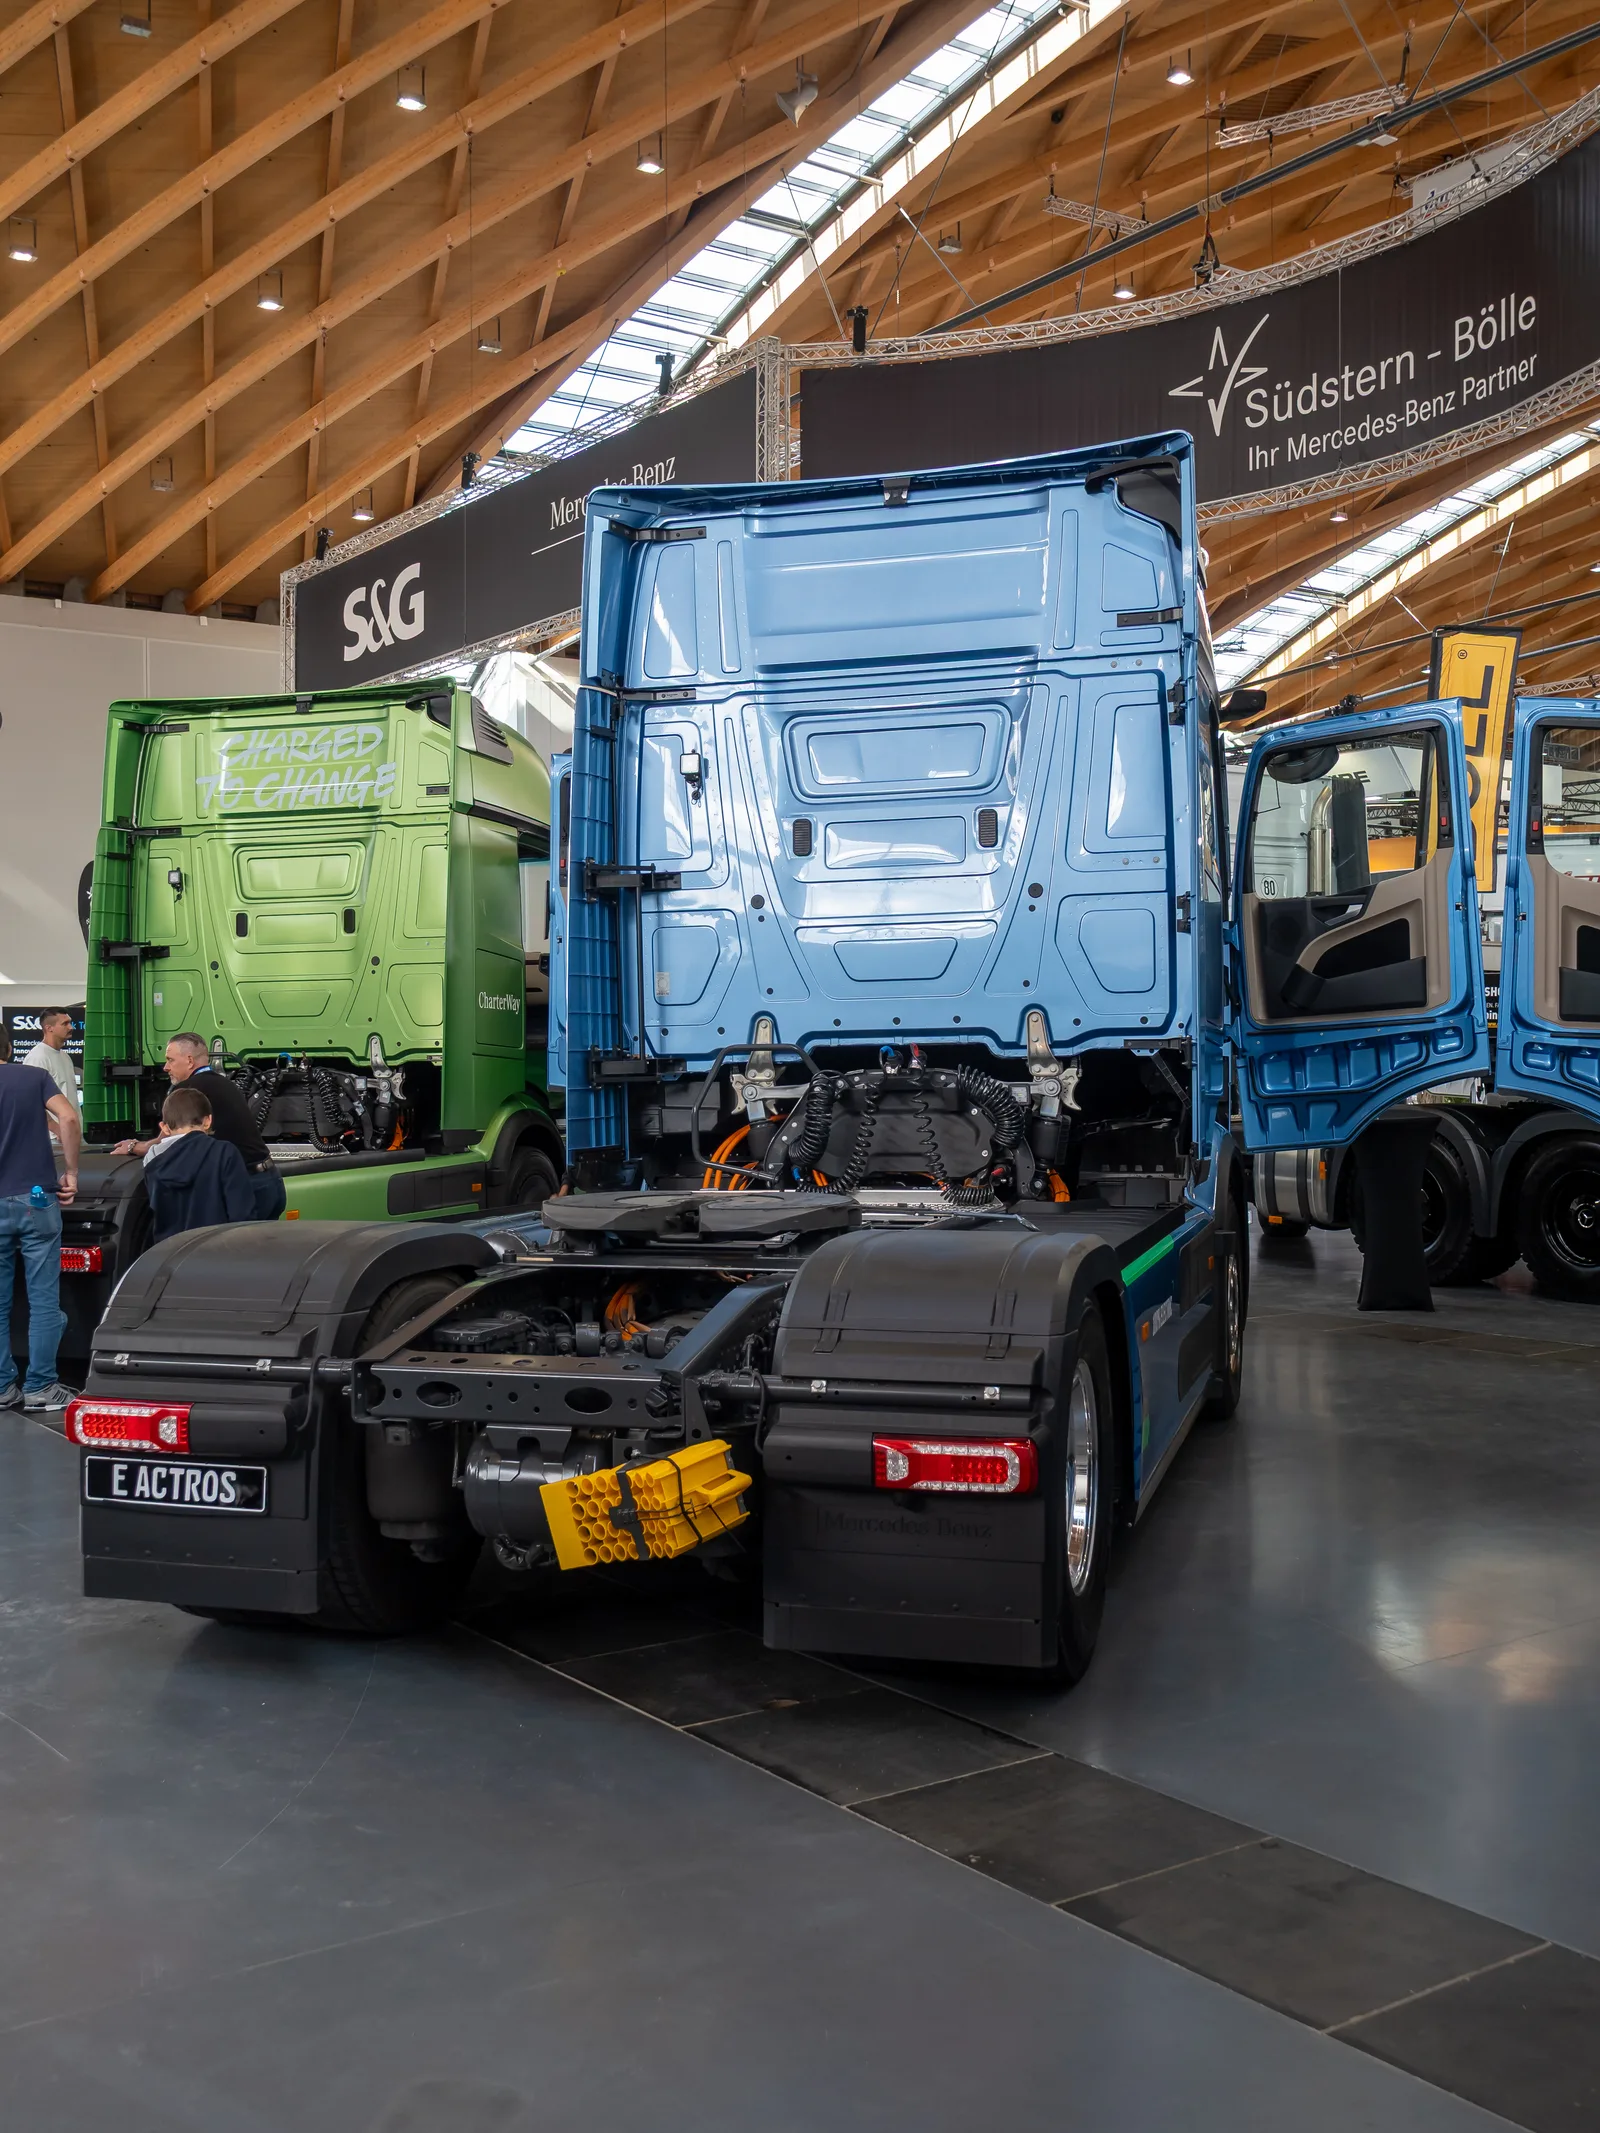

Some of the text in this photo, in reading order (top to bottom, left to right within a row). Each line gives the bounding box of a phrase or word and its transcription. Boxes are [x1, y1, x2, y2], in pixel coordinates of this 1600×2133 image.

[1245, 349, 1415, 429] Südstern
[1454, 292, 1538, 362] Bölle
[1248, 353, 1538, 472] Ihr Mercedes-Benz Partner
[342, 562, 425, 662] S&G
[218, 724, 384, 769] CHARGED
[195, 762, 398, 810] TO CHANGE
[1263, 879, 1276, 896] 80
[477, 990, 521, 1015] CharterWay
[112, 1463, 237, 1504] E ACTROS
